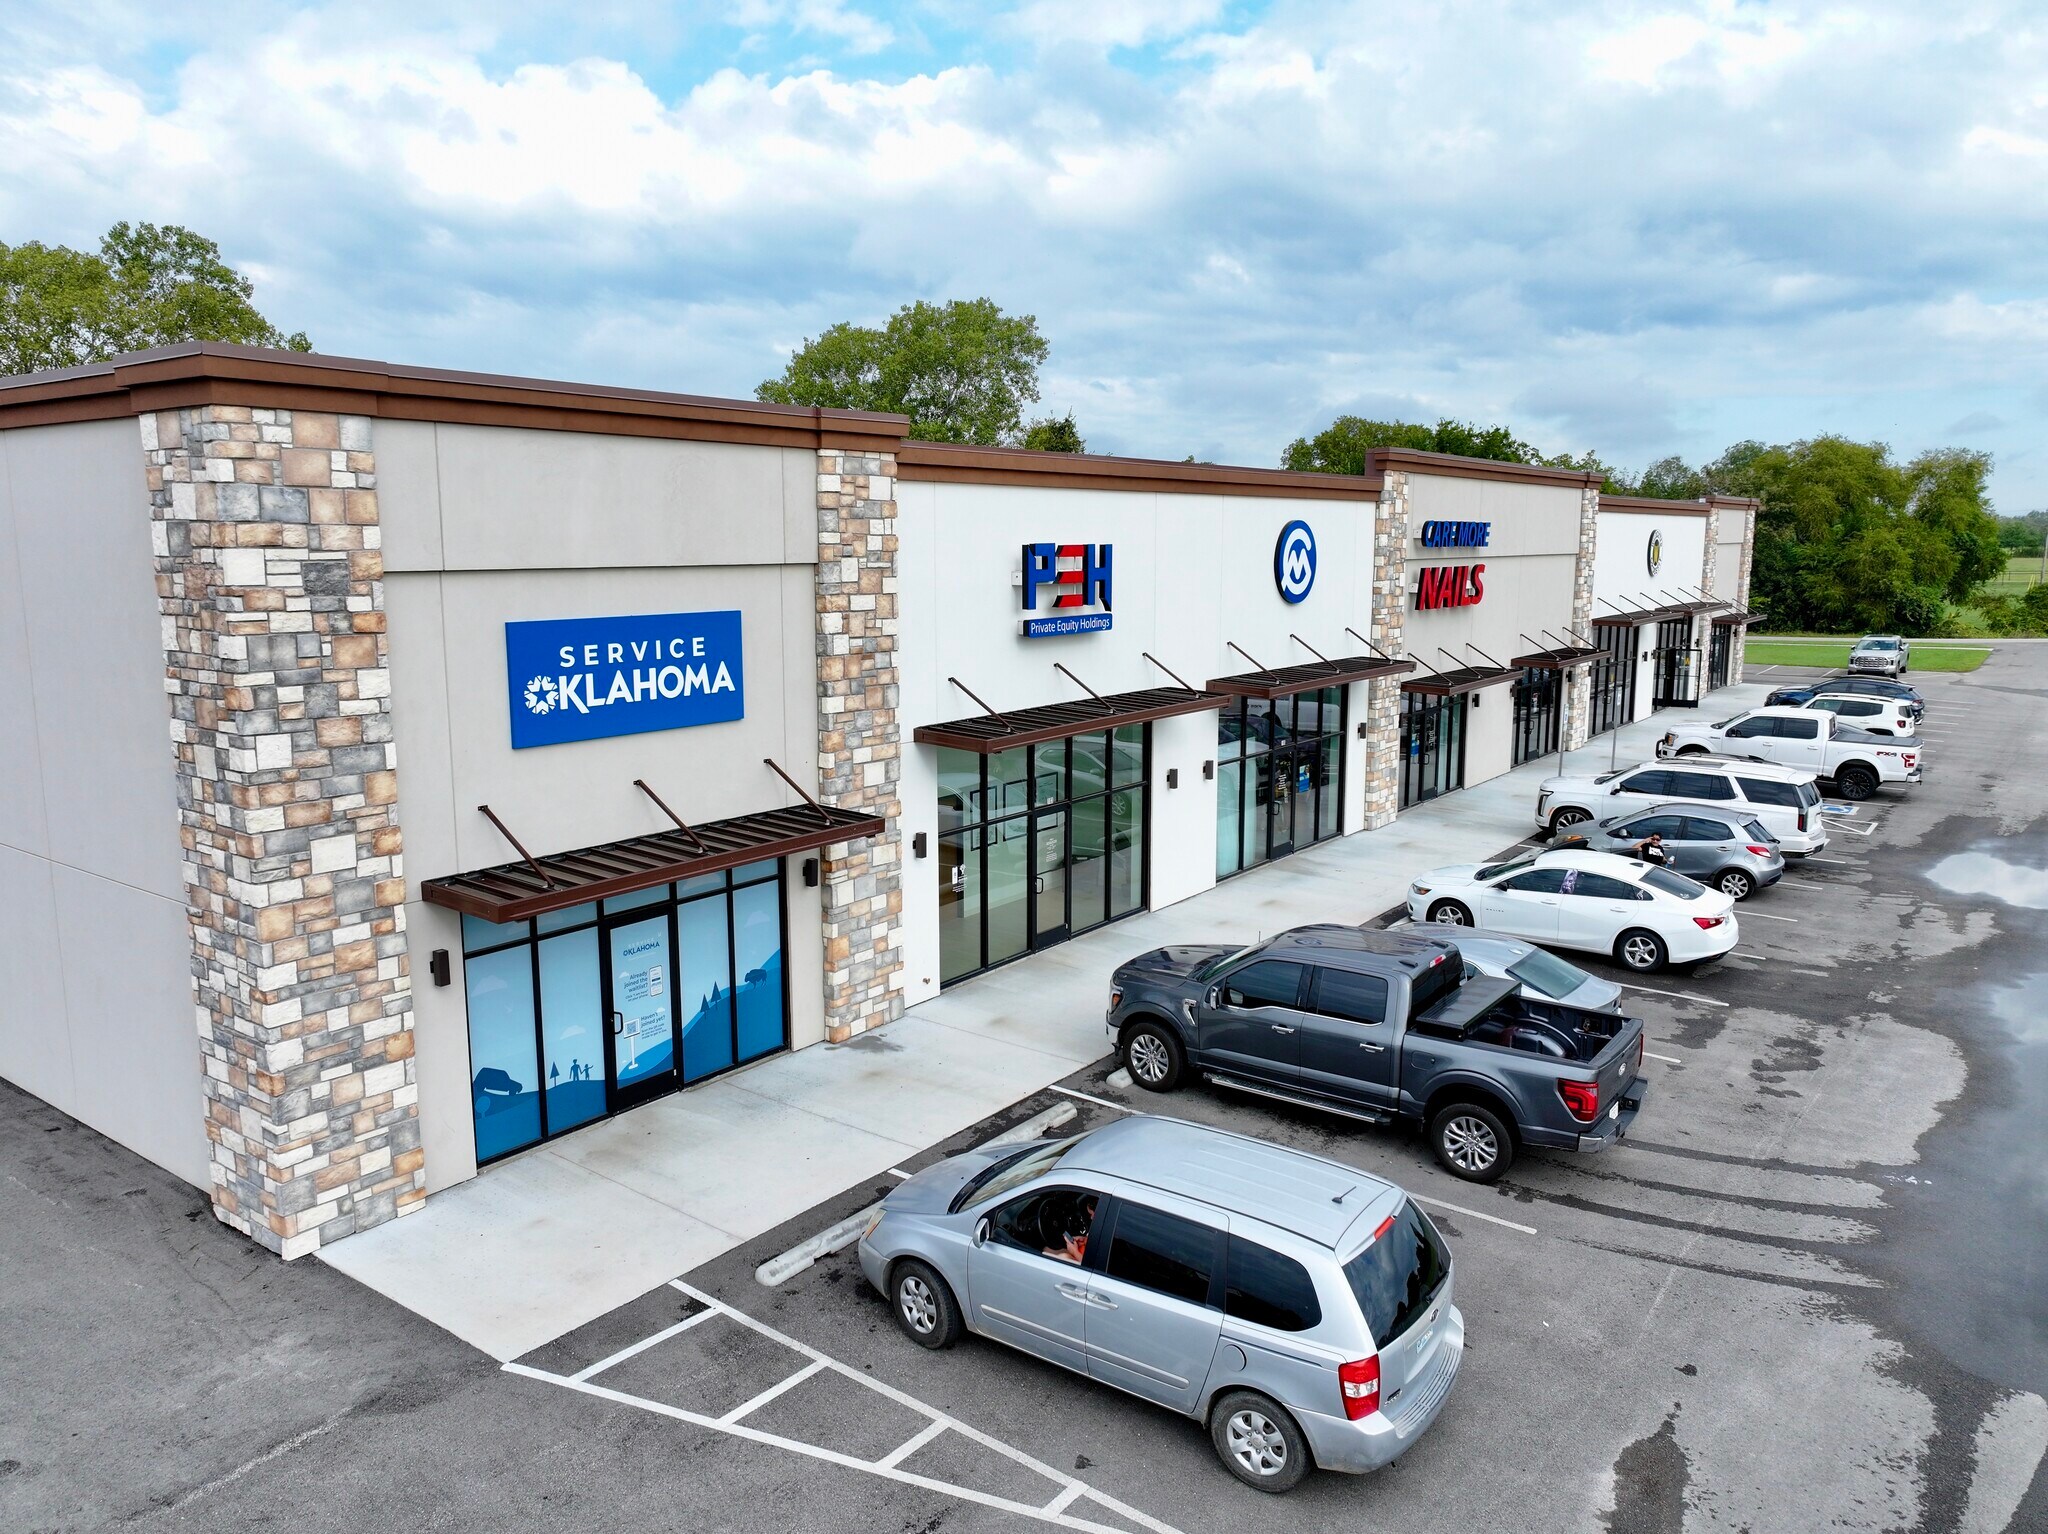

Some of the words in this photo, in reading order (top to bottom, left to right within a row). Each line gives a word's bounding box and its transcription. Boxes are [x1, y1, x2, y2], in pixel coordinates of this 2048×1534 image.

[1421, 520, 1457, 547] CARE
[1457, 521, 1491, 547] MORE
[1415, 563, 1486, 610] NAILS
[1030, 622, 1056, 634] Private
[1056, 620, 1080, 633] Equity
[1080, 617, 1110, 630] Holdings
[559, 636, 706, 668] SERVICE
[623, 941, 660, 956] OKLAHOMA
[629, 971, 648, 980] Already
